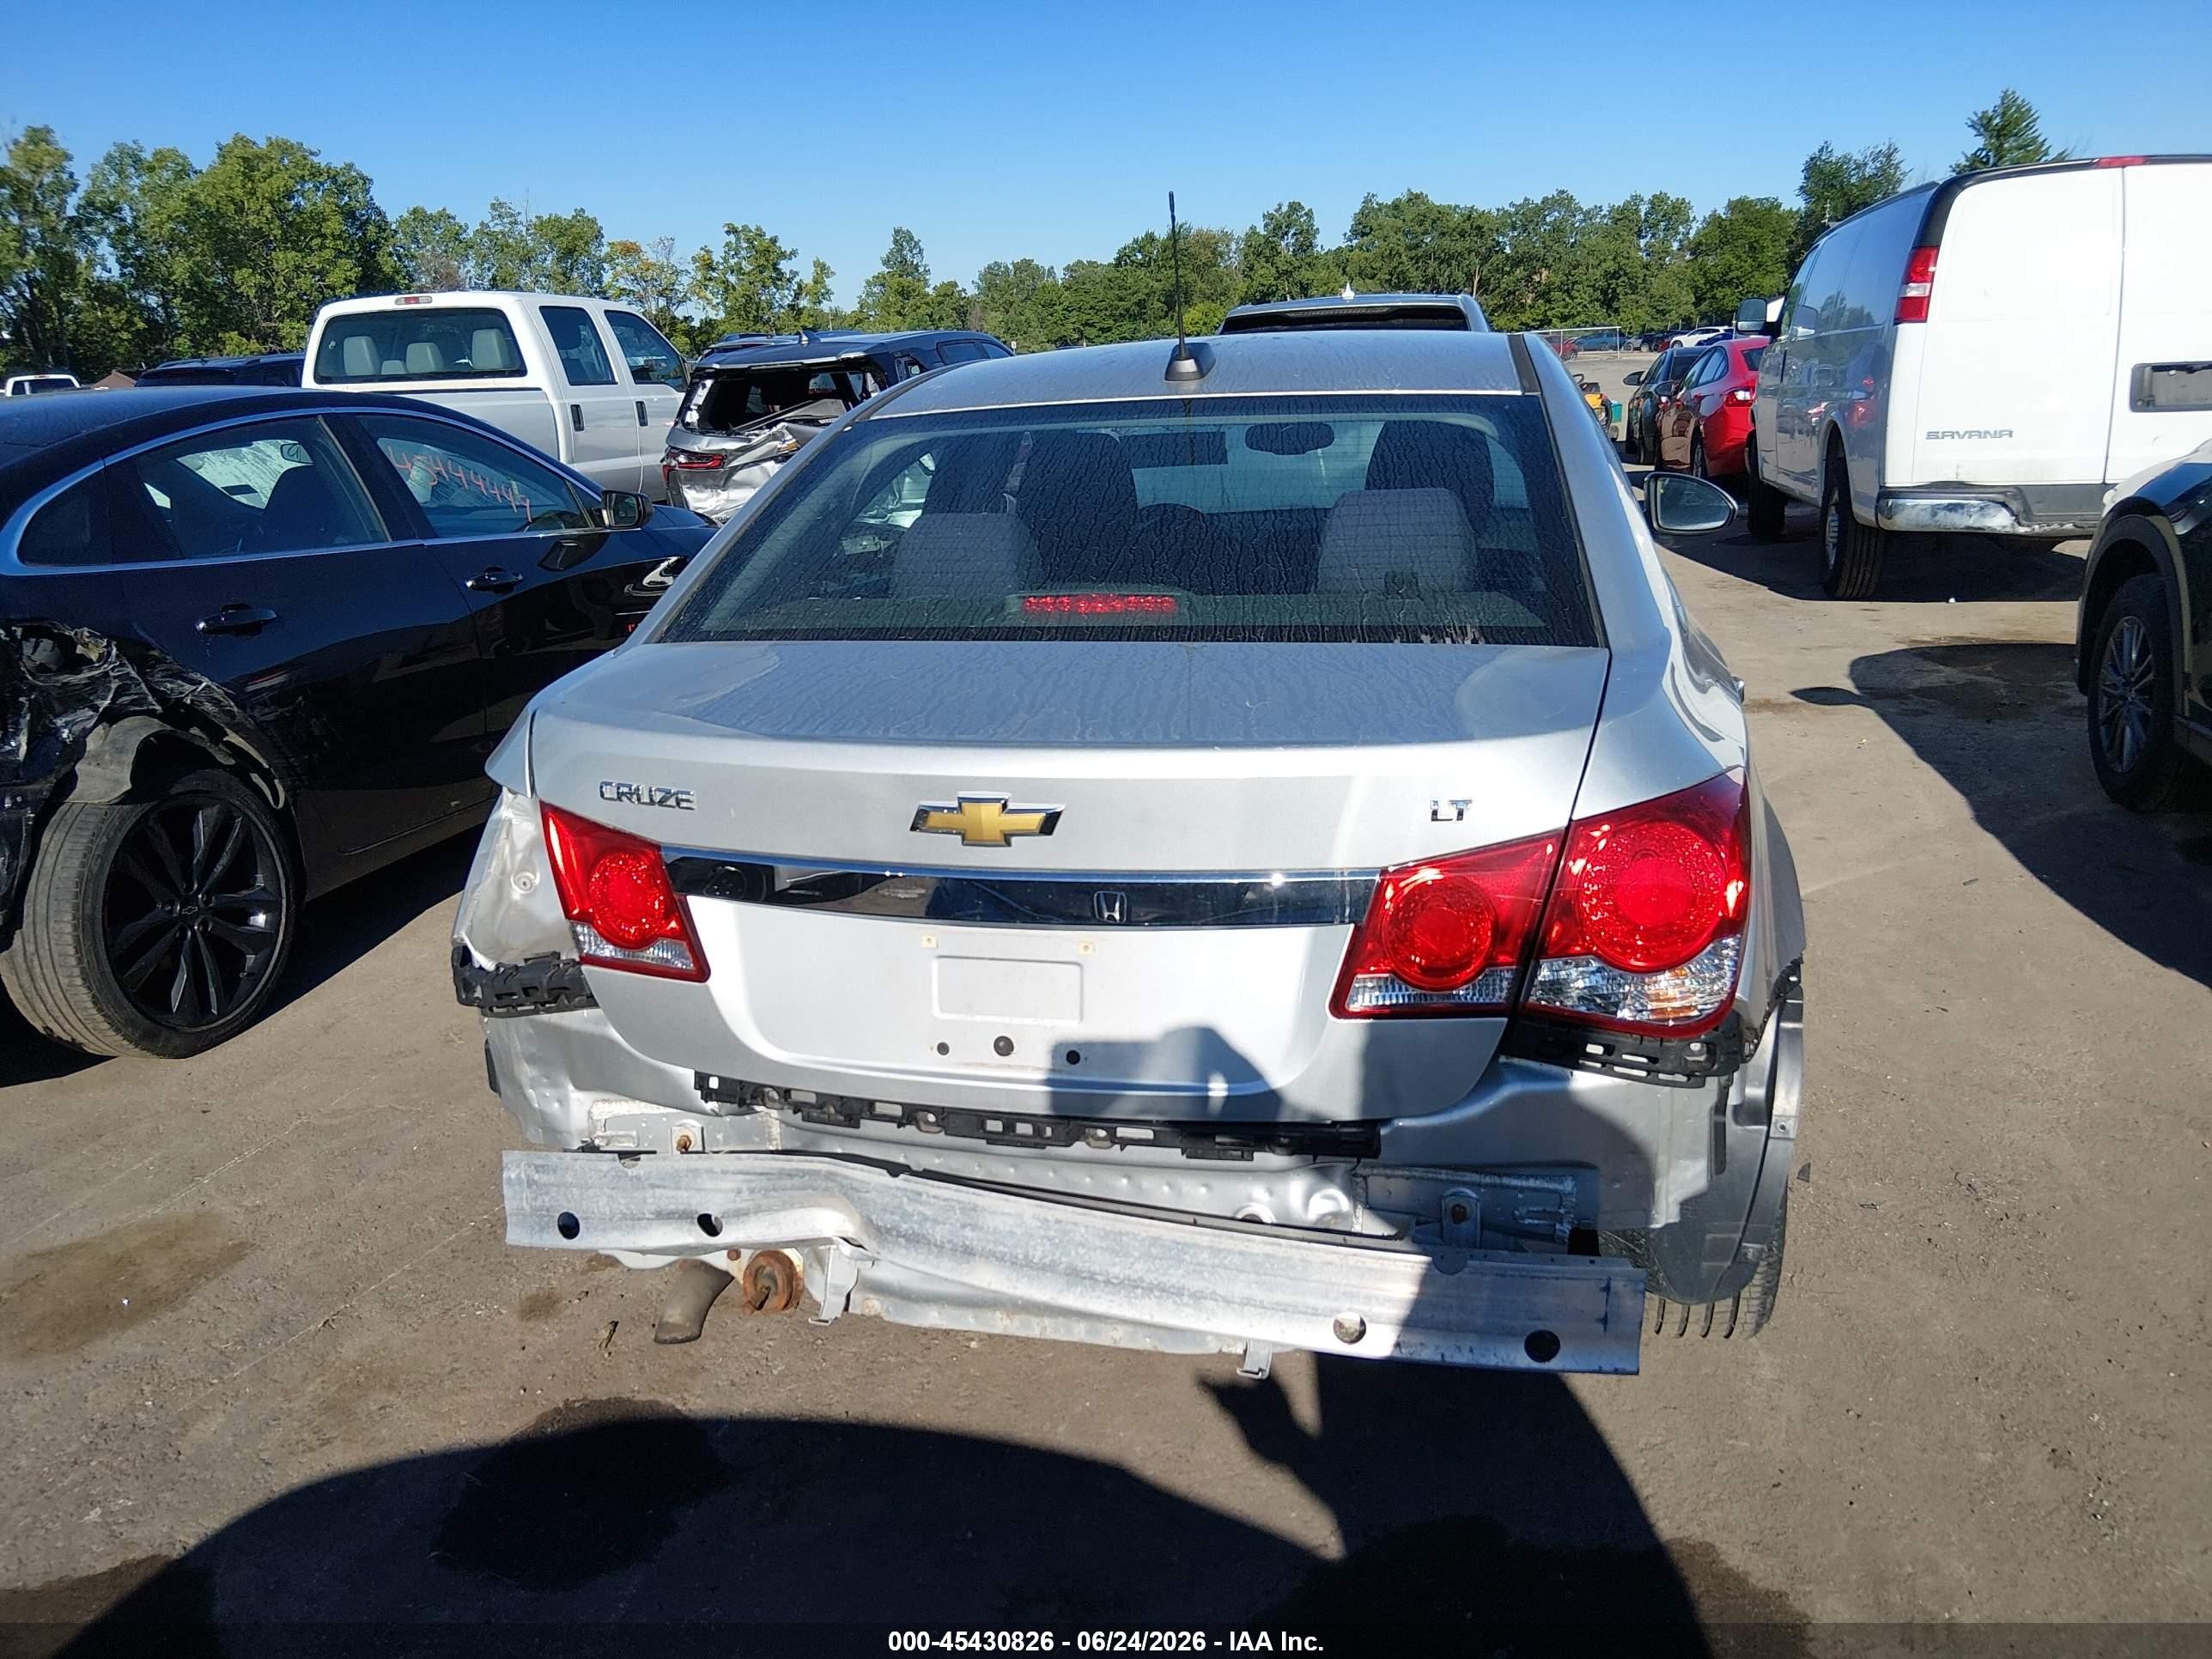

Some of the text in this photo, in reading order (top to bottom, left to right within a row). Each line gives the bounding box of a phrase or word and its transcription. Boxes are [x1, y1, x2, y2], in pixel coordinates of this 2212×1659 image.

[1925, 429, 2014, 440] SAVANA
[599, 781, 697, 811] CRUZE
[1431, 799, 1473, 822] LT
